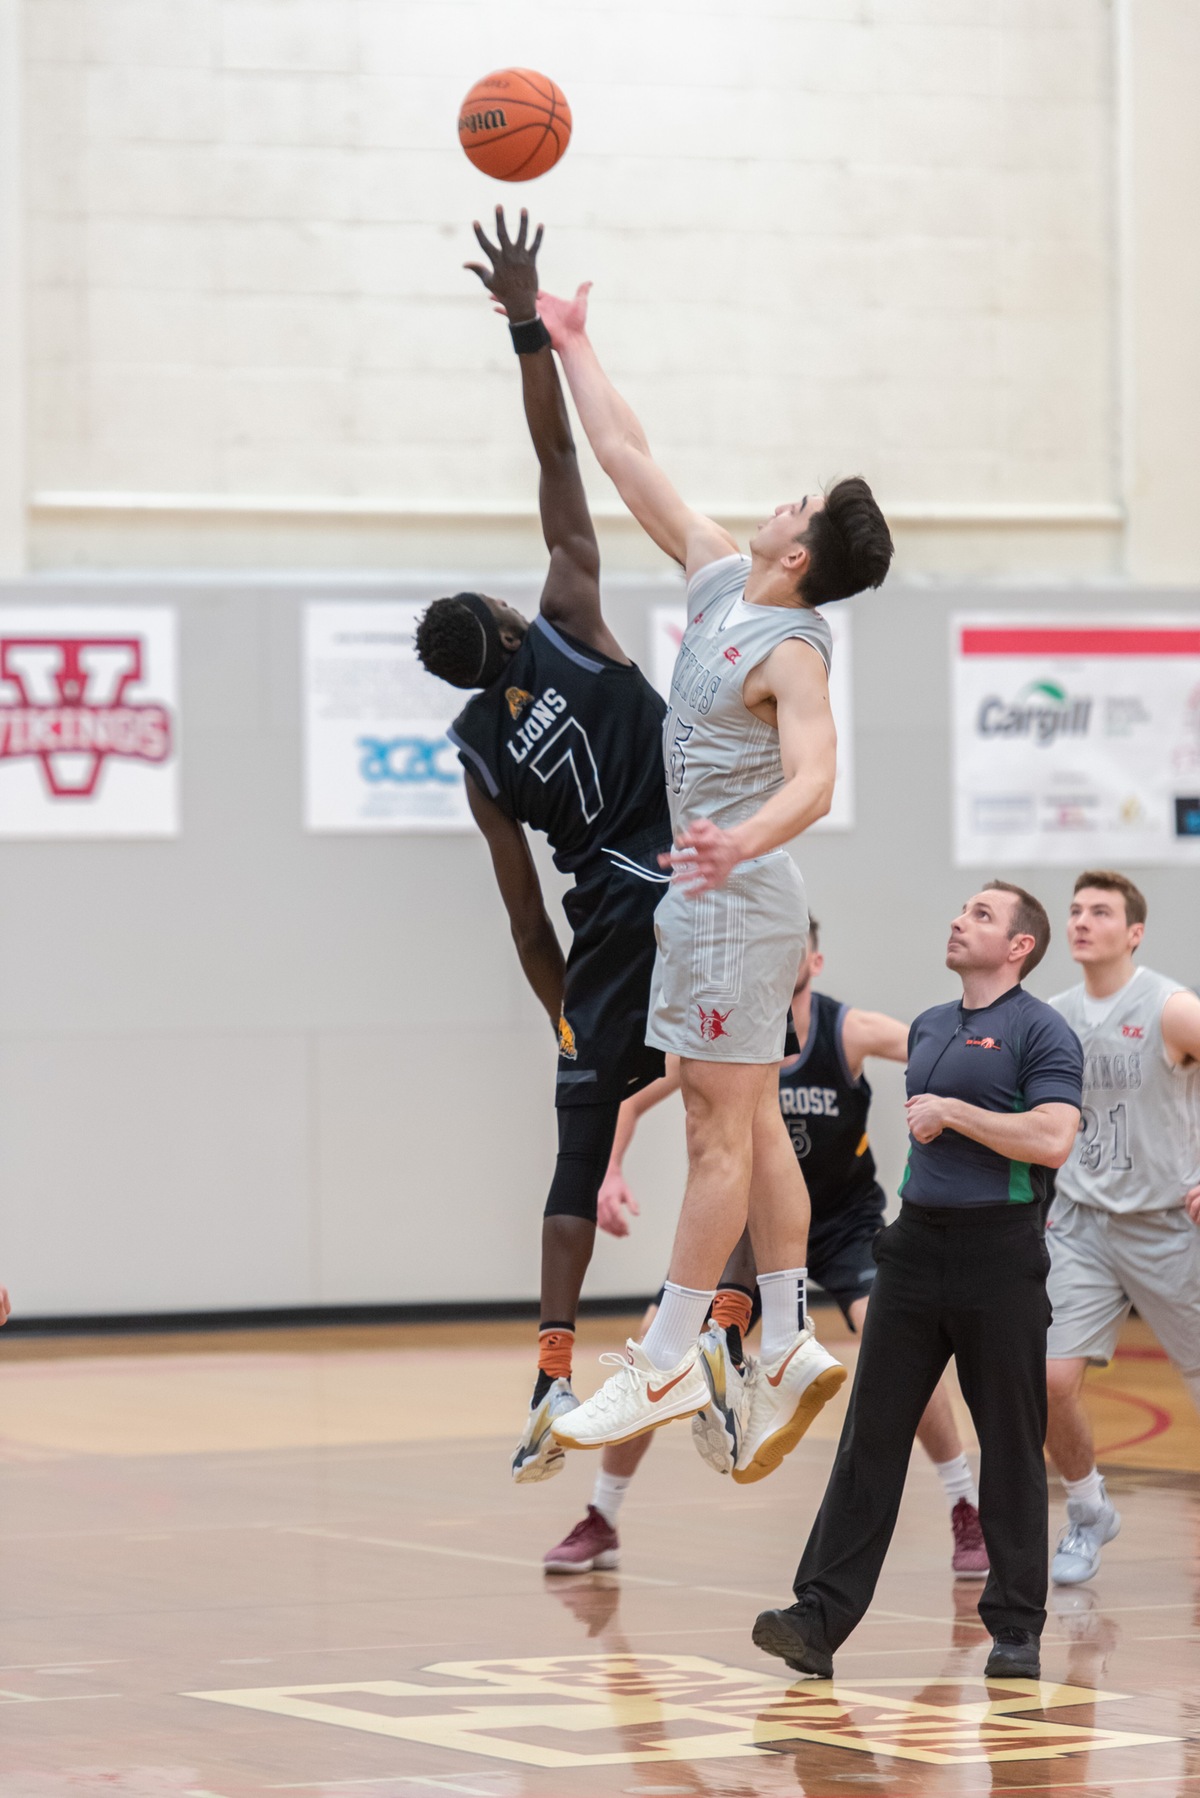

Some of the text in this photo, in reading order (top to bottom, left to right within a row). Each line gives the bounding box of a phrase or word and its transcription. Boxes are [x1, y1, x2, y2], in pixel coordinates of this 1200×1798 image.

[506, 687, 568, 764] LIONS
[976, 697, 1092, 747] Cargill
[529, 715, 605, 825] 7
[780, 1086, 840, 1117] ROSE
[786, 1118, 812, 1159] 5
